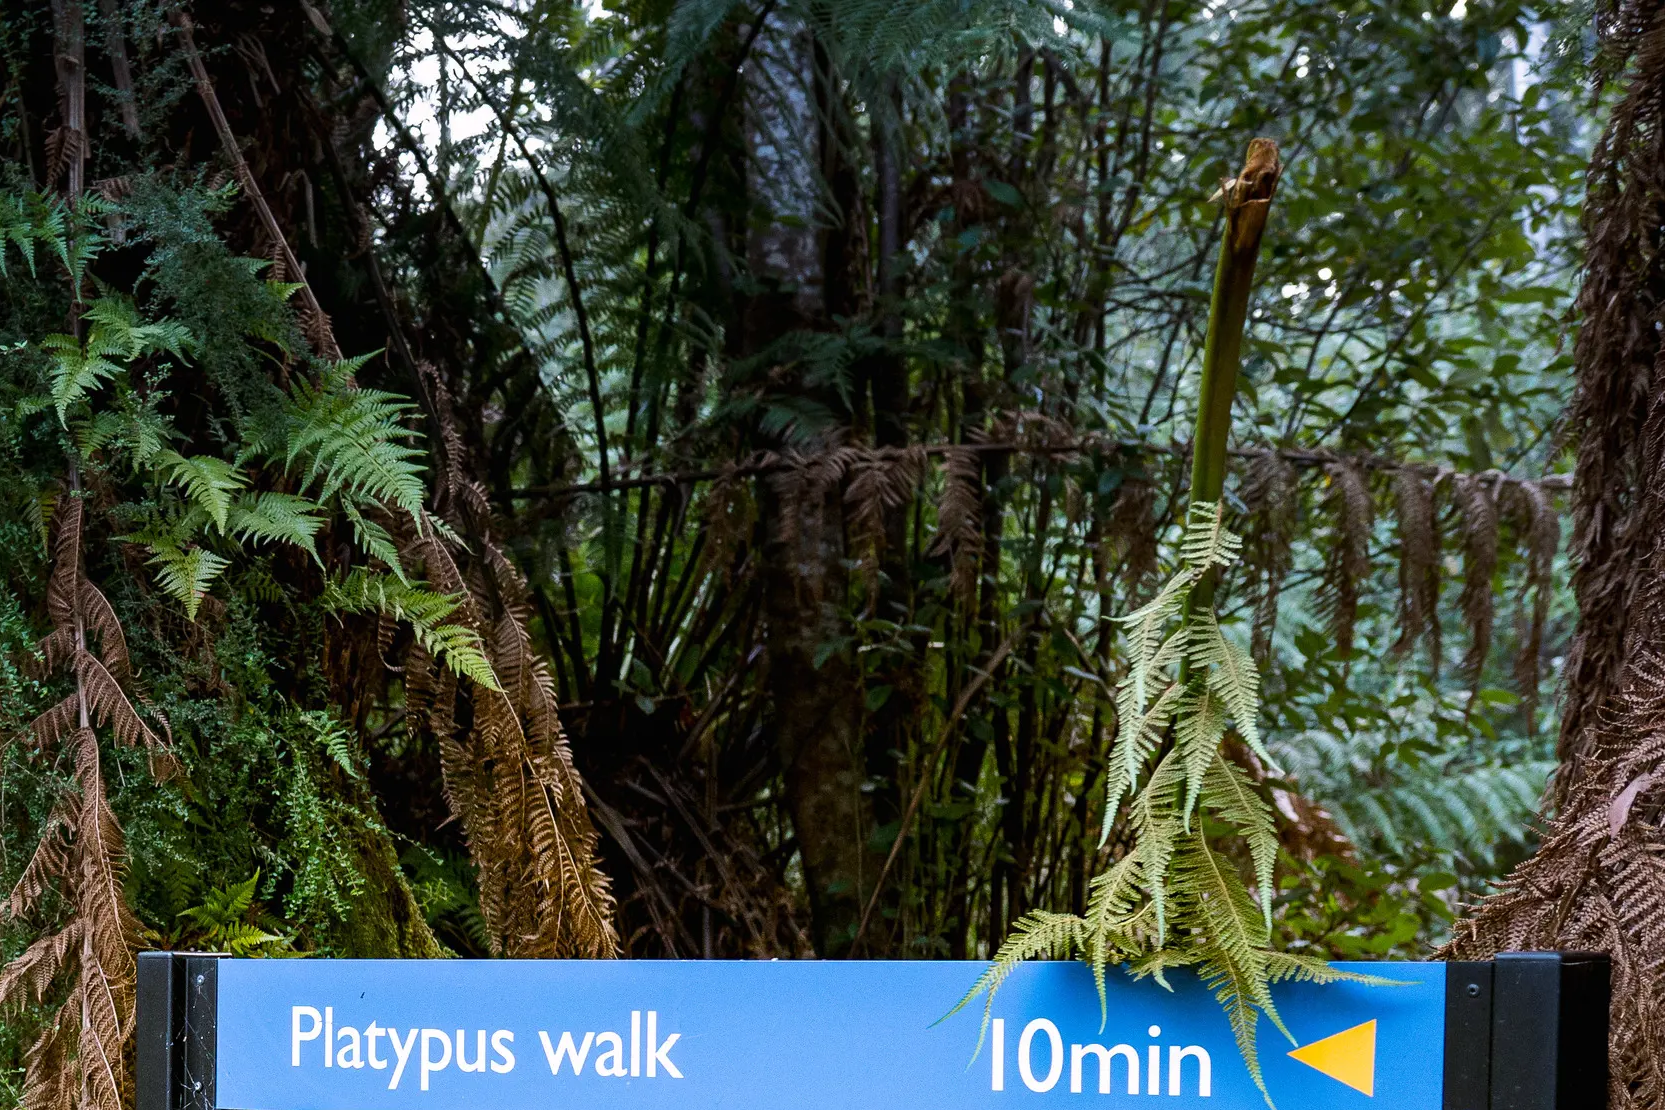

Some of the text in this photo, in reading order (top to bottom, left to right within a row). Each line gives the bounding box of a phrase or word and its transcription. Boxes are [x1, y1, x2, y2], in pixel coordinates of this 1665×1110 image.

[291, 1005, 1211, 1097] Platypus walk 10min
